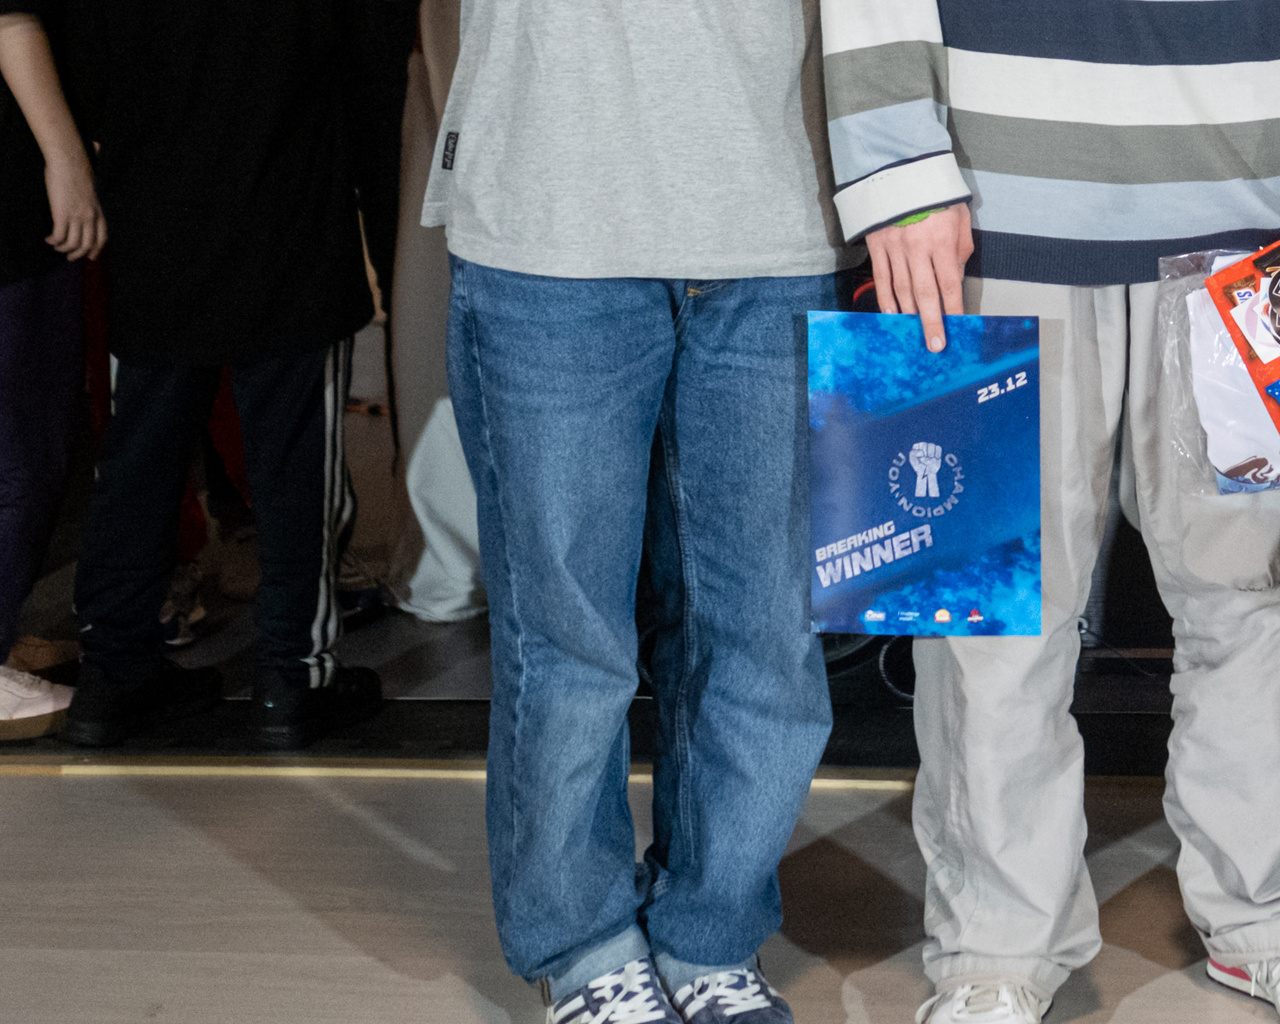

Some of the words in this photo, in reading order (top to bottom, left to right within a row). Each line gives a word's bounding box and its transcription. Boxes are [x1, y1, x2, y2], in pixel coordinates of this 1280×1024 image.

[977, 371, 1028, 404] 23.12
[815, 521, 896, 562] BREAKING
[815, 525, 933, 588] WINNER
